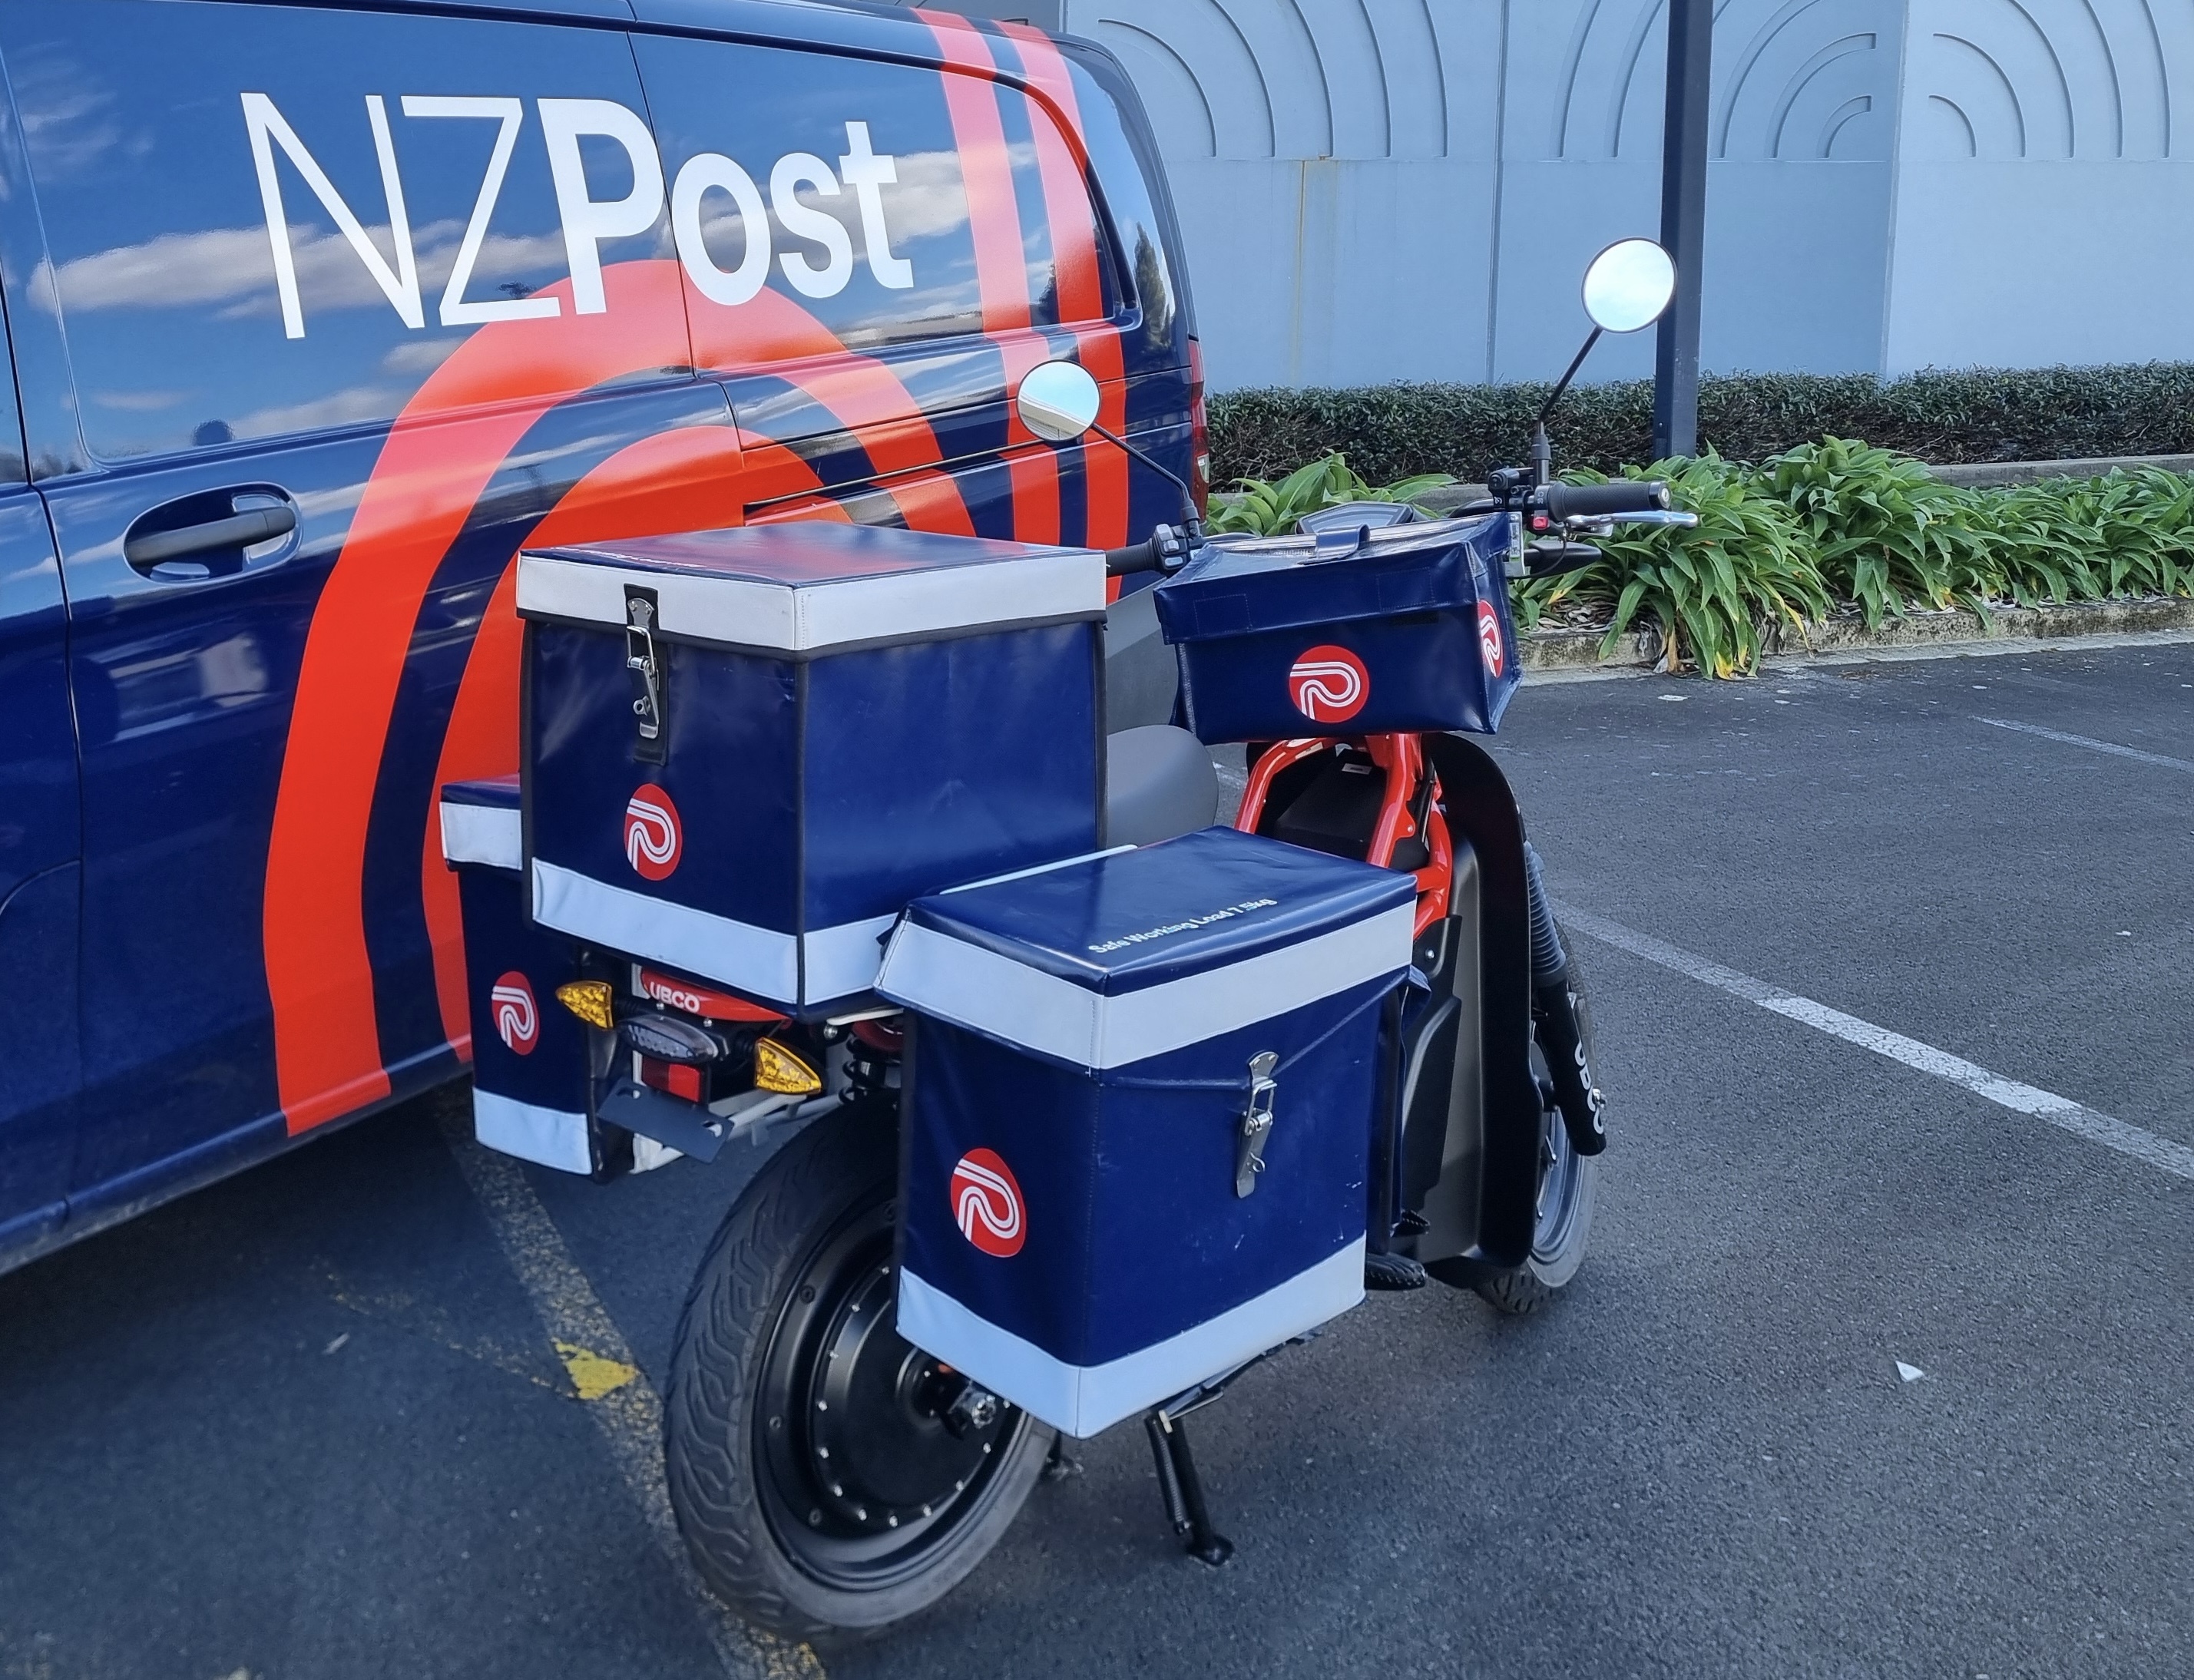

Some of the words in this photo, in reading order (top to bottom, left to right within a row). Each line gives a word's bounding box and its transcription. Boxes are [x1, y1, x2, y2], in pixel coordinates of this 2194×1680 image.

[1088, 939, 1131, 954] Safe
[1123, 921, 1200, 944] Working
[1189, 910, 1236, 925] Load
[650, 981, 700, 1014] UBCO
